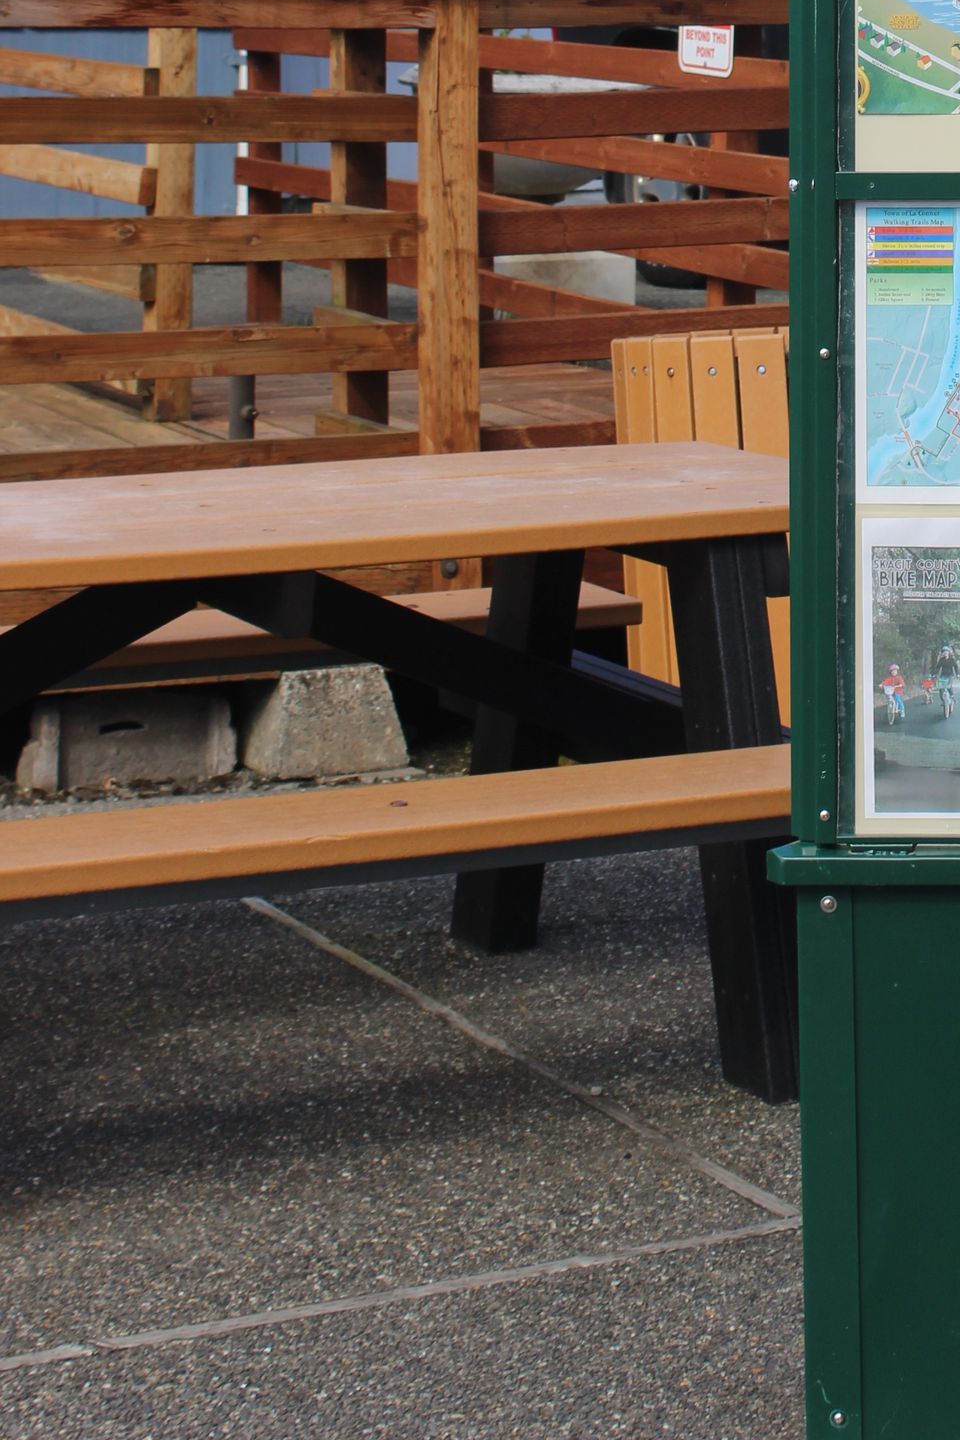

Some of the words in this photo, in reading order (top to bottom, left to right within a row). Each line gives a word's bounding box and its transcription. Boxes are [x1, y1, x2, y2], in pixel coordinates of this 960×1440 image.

[685, 29, 710, 42] BEYOND
[713, 32, 727, 44] THIS
[696, 46, 715, 58] POINT
[874, 559, 913, 570] SKAGIT
[879, 571, 916, 588] BIKE
[922, 571, 958, 588] MAP
